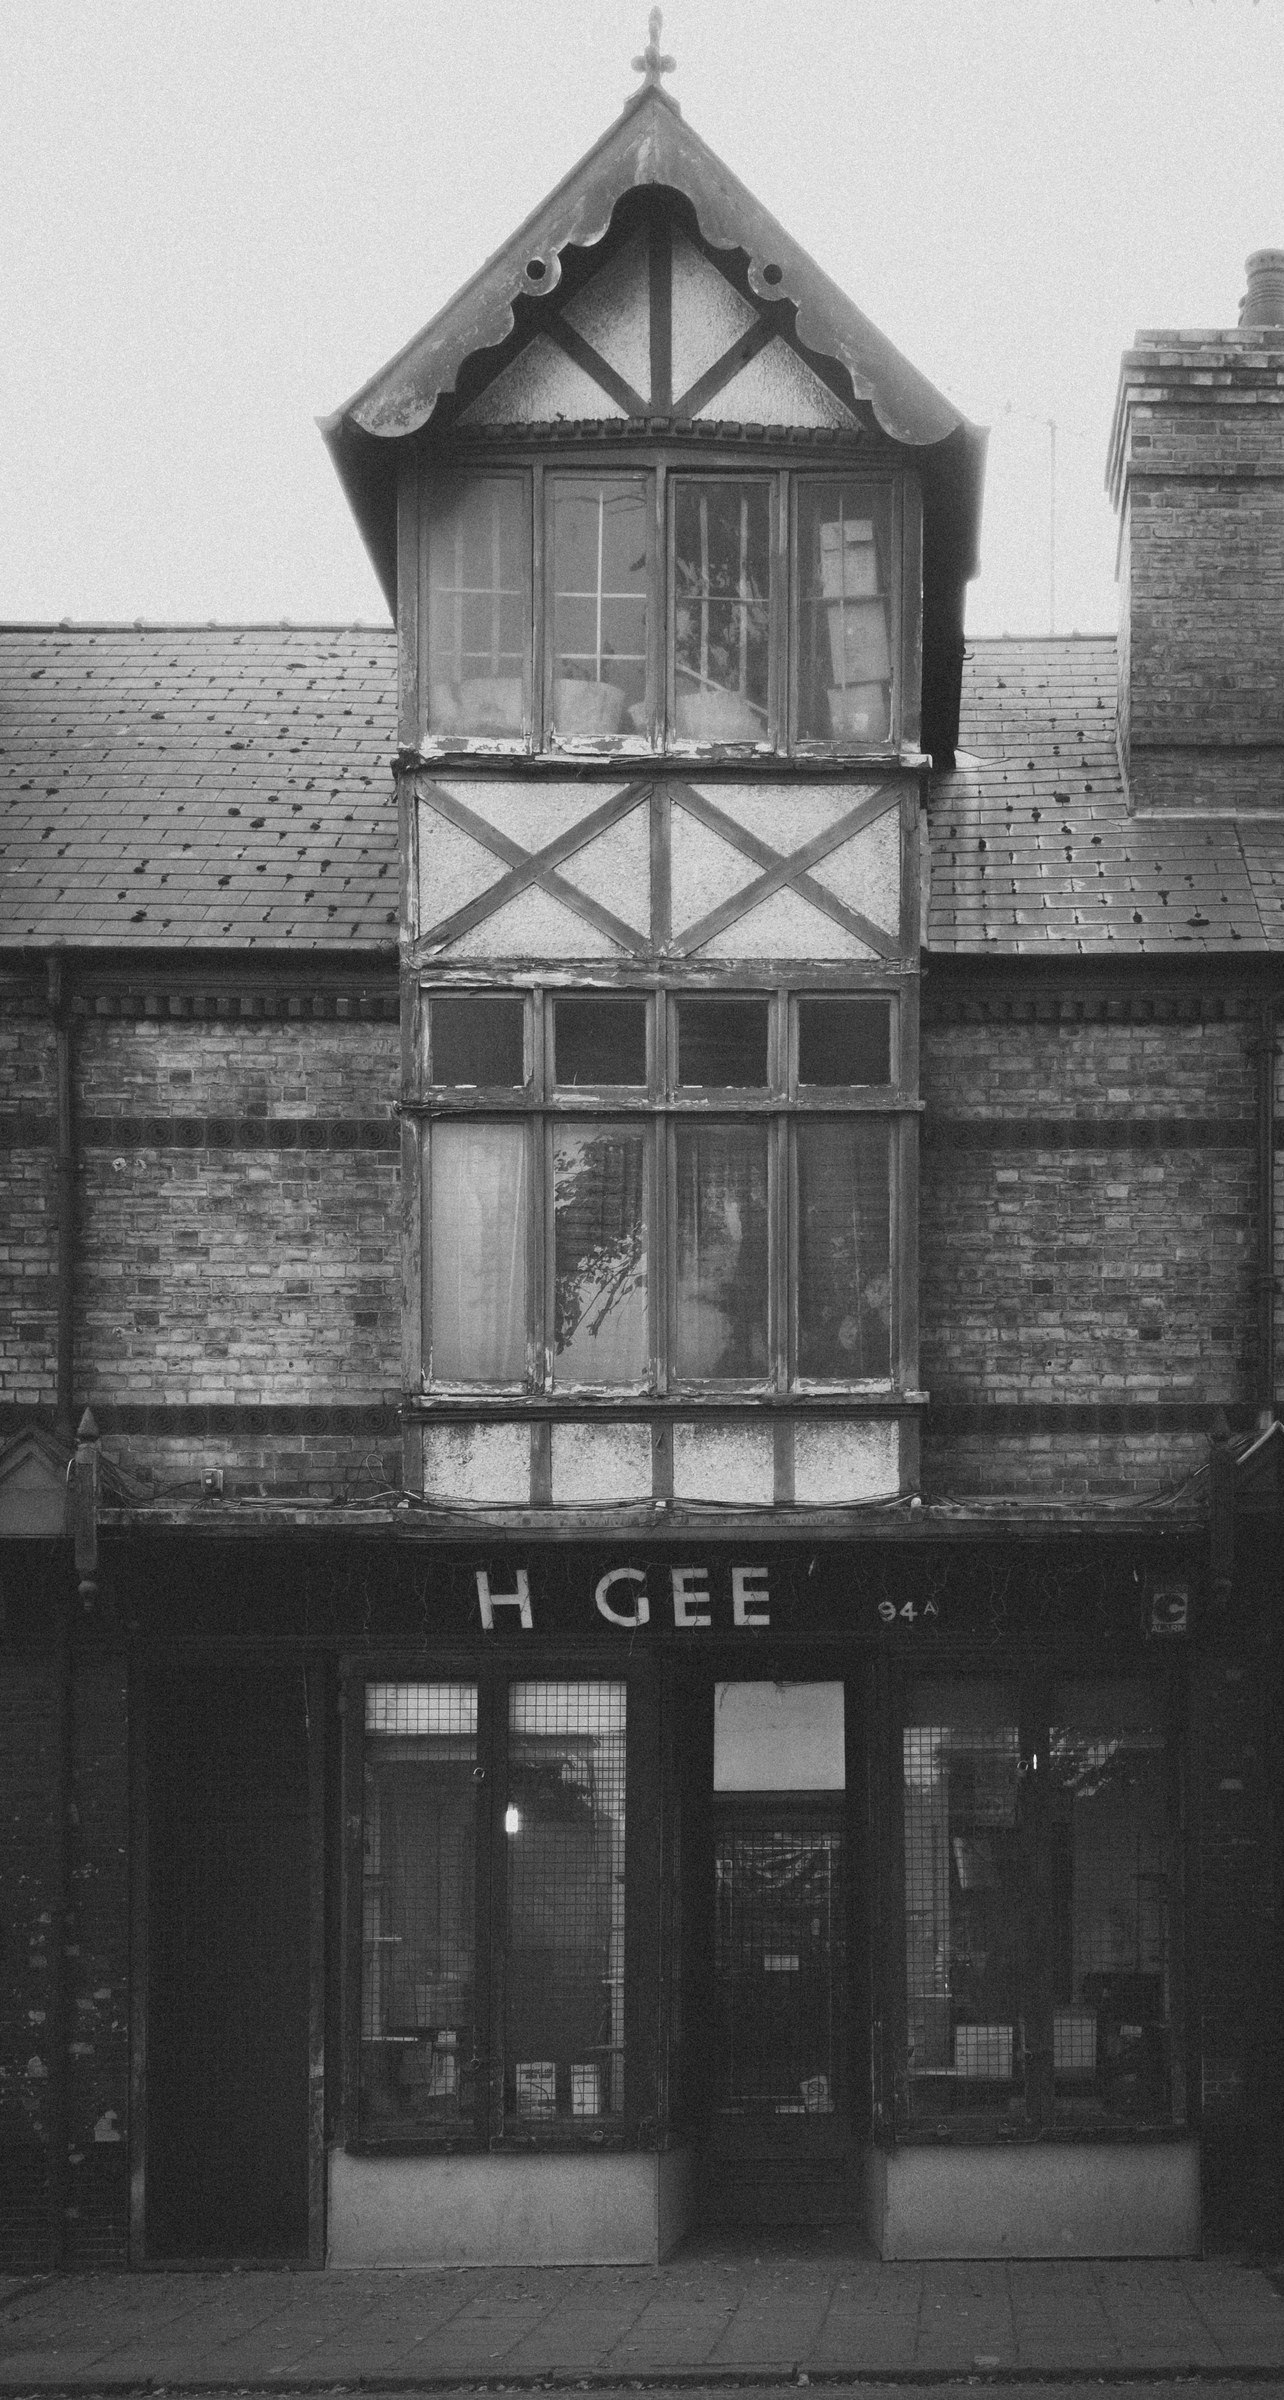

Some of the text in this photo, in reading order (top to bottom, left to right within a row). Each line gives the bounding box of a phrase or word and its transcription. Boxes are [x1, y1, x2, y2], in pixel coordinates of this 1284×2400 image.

[475, 1567, 771, 1630] H GEE
[1151, 1624, 1187, 1634] ALARM
